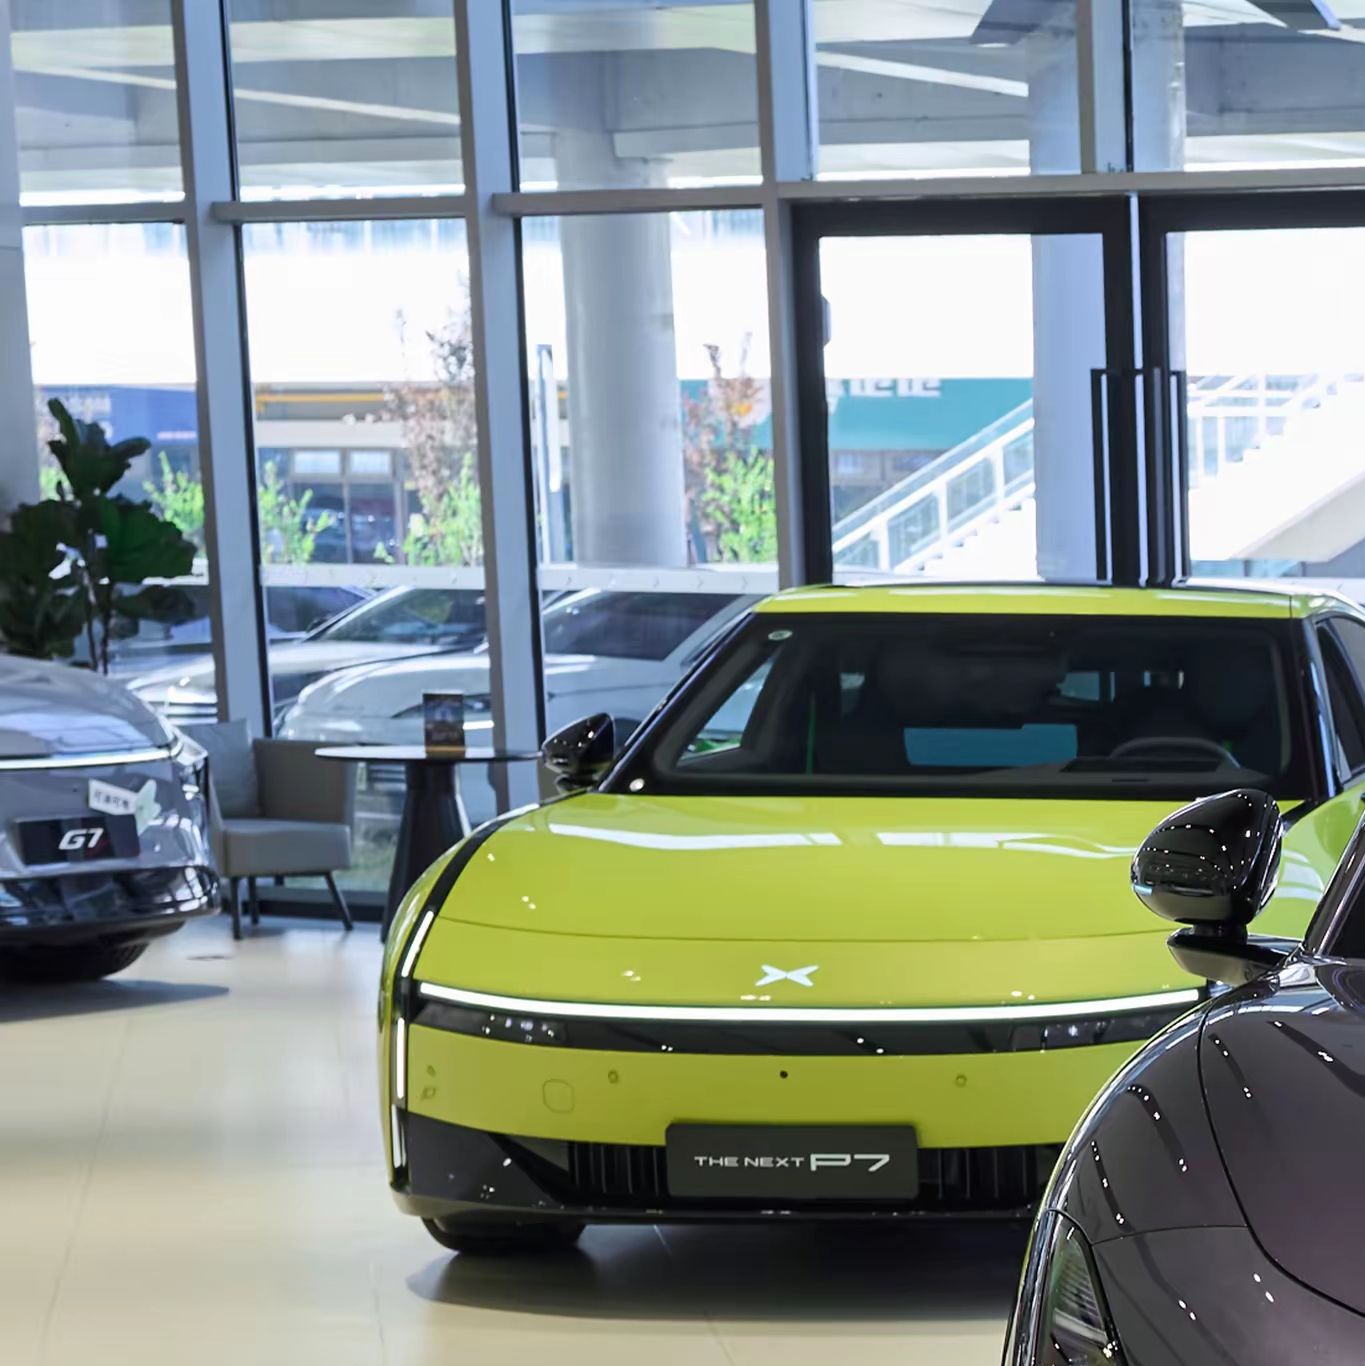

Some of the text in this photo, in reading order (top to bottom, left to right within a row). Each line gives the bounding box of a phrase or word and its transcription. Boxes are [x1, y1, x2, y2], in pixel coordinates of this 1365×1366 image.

[58, 827, 104, 850] G7
[694, 1154, 890, 1172] THE NEXT P7
